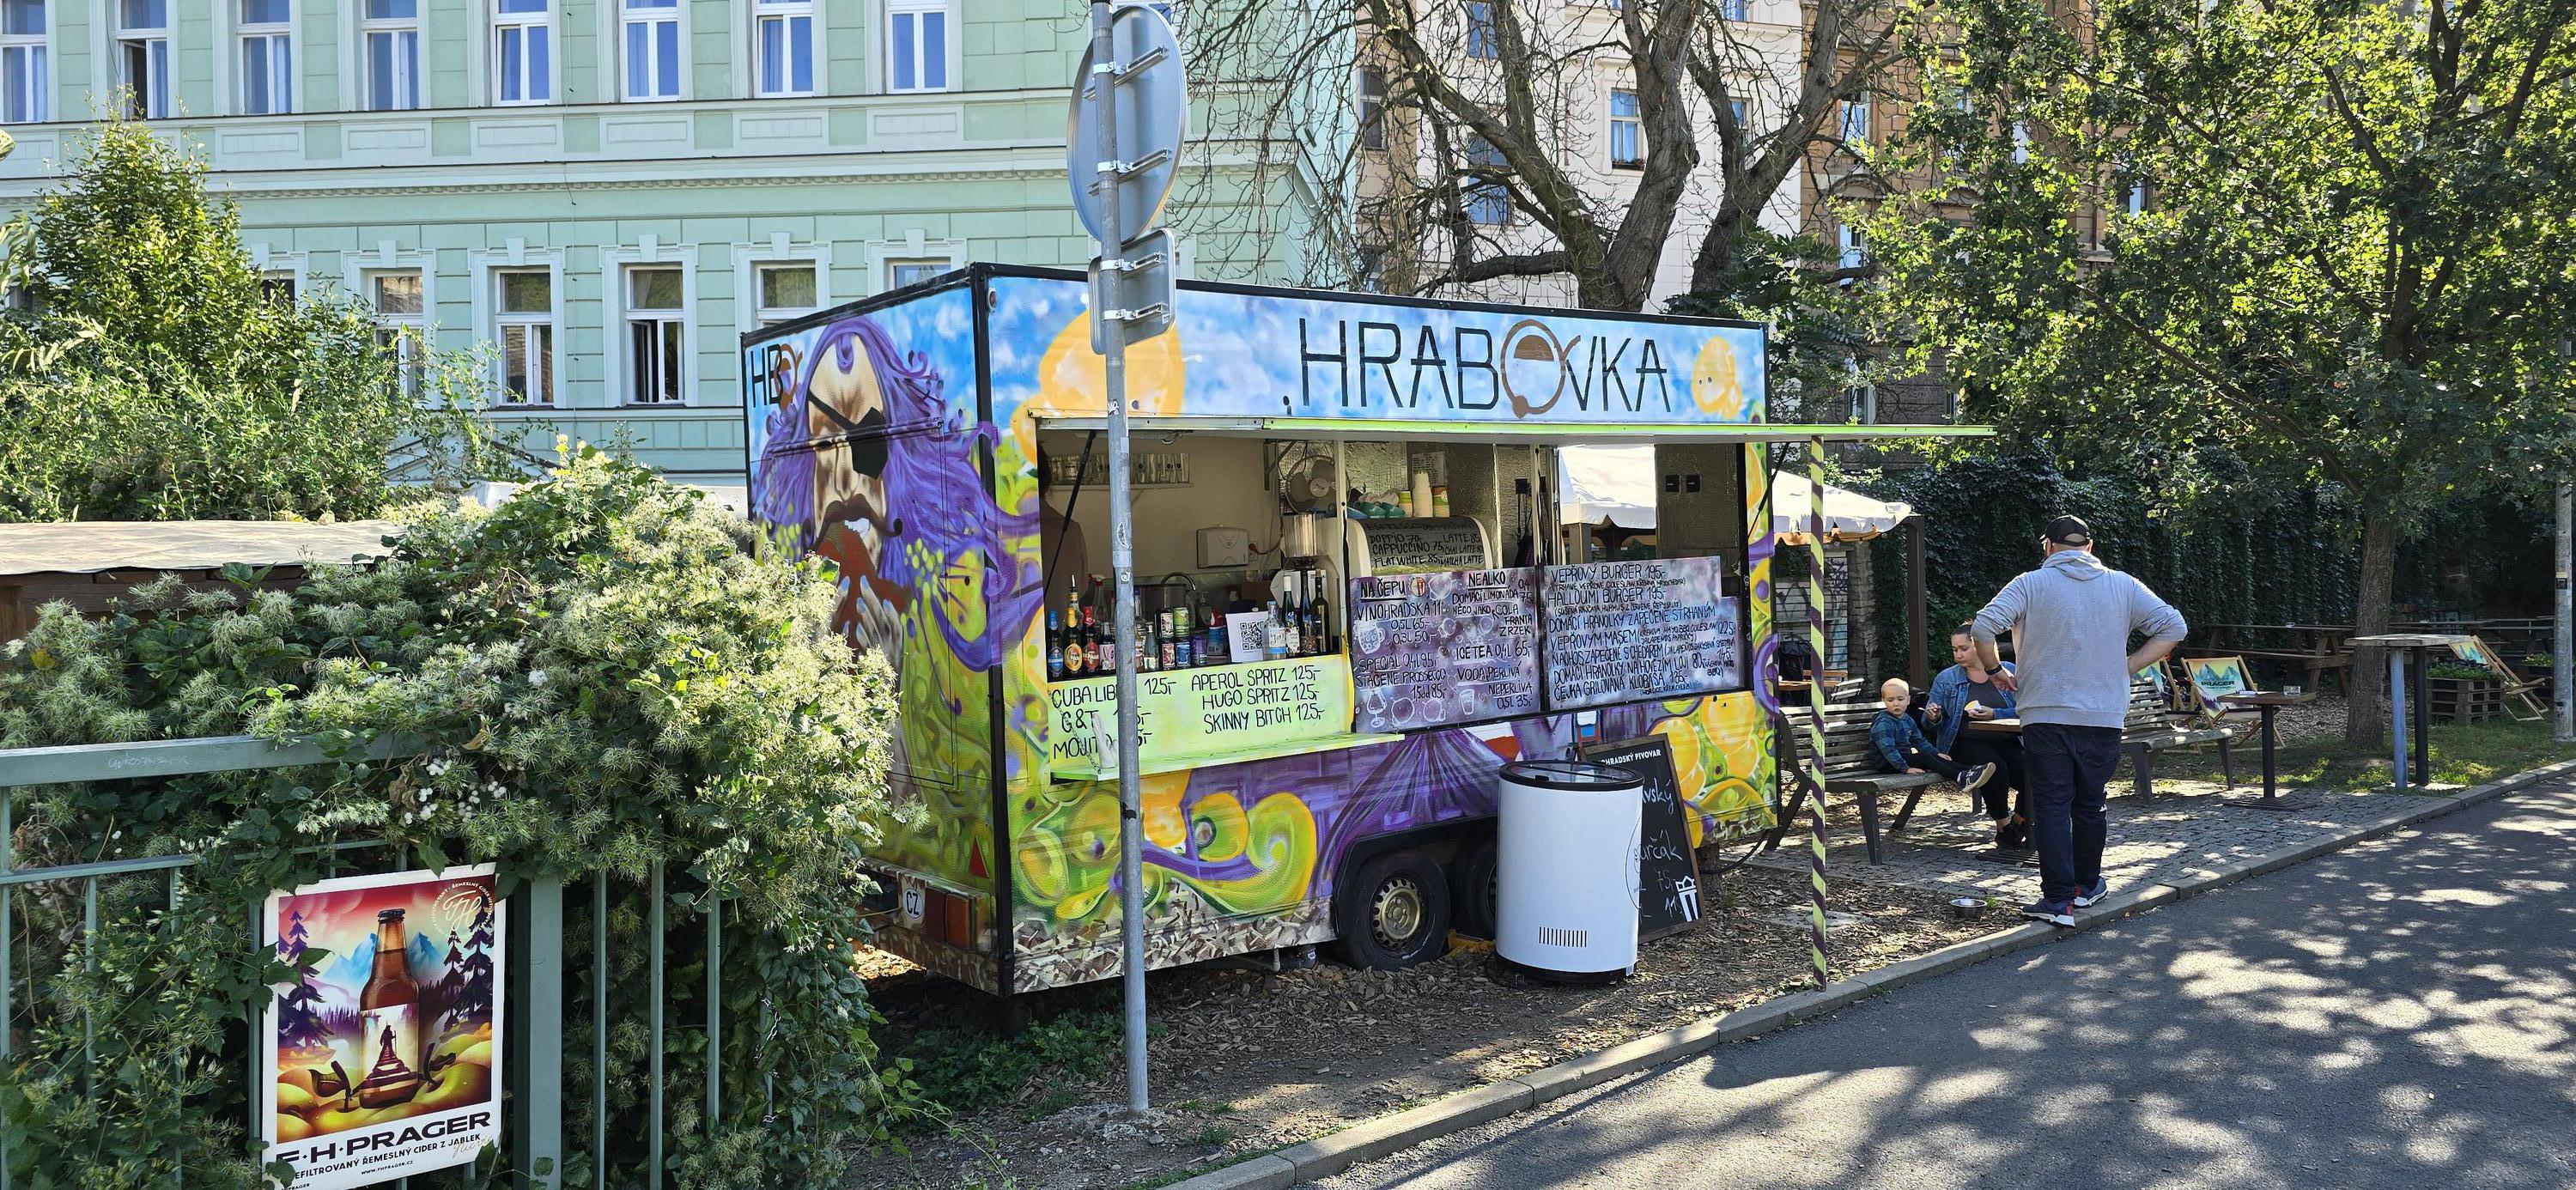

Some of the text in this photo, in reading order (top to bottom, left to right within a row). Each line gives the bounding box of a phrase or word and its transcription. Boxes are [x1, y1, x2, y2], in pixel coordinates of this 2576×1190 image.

[1299, 318, 1672, 419] HRABOVKA
[1372, 542, 1431, 556] CAPPUCCINO
[1468, 571, 1506, 587] NEALKO
[1551, 563, 1598, 583] VEPŘOVÝ
[1601, 563, 1643, 580] BURGER
[1376, 578, 1406, 598] ČEPU
[1547, 589, 1599, 608] HALLOUMI
[1602, 586, 1643, 604] BURGER
[1191, 671, 1244, 692] APEROL
[1247, 667, 1287, 686] SPRITZ
[1052, 686, 1091, 708] CUBA
[1202, 689, 1242, 711] HUGO
[1247, 687, 1291, 705] SPRITZ
[1204, 712, 1249, 734] SKINNY
[1255, 707, 1292, 727] BITCH
[1635, 749, 1662, 761] PIVOVAR
[905, 891, 920, 916] CZ
[295, 1158, 360, 1180] EFILTROVANÝ
[362, 1147, 412, 1165] ŘEMESLNÝ
[413, 1143, 438, 1155] CIDER
[440, 1140, 446, 1149] Z
[448, 1132, 481, 1147] JABLEK
